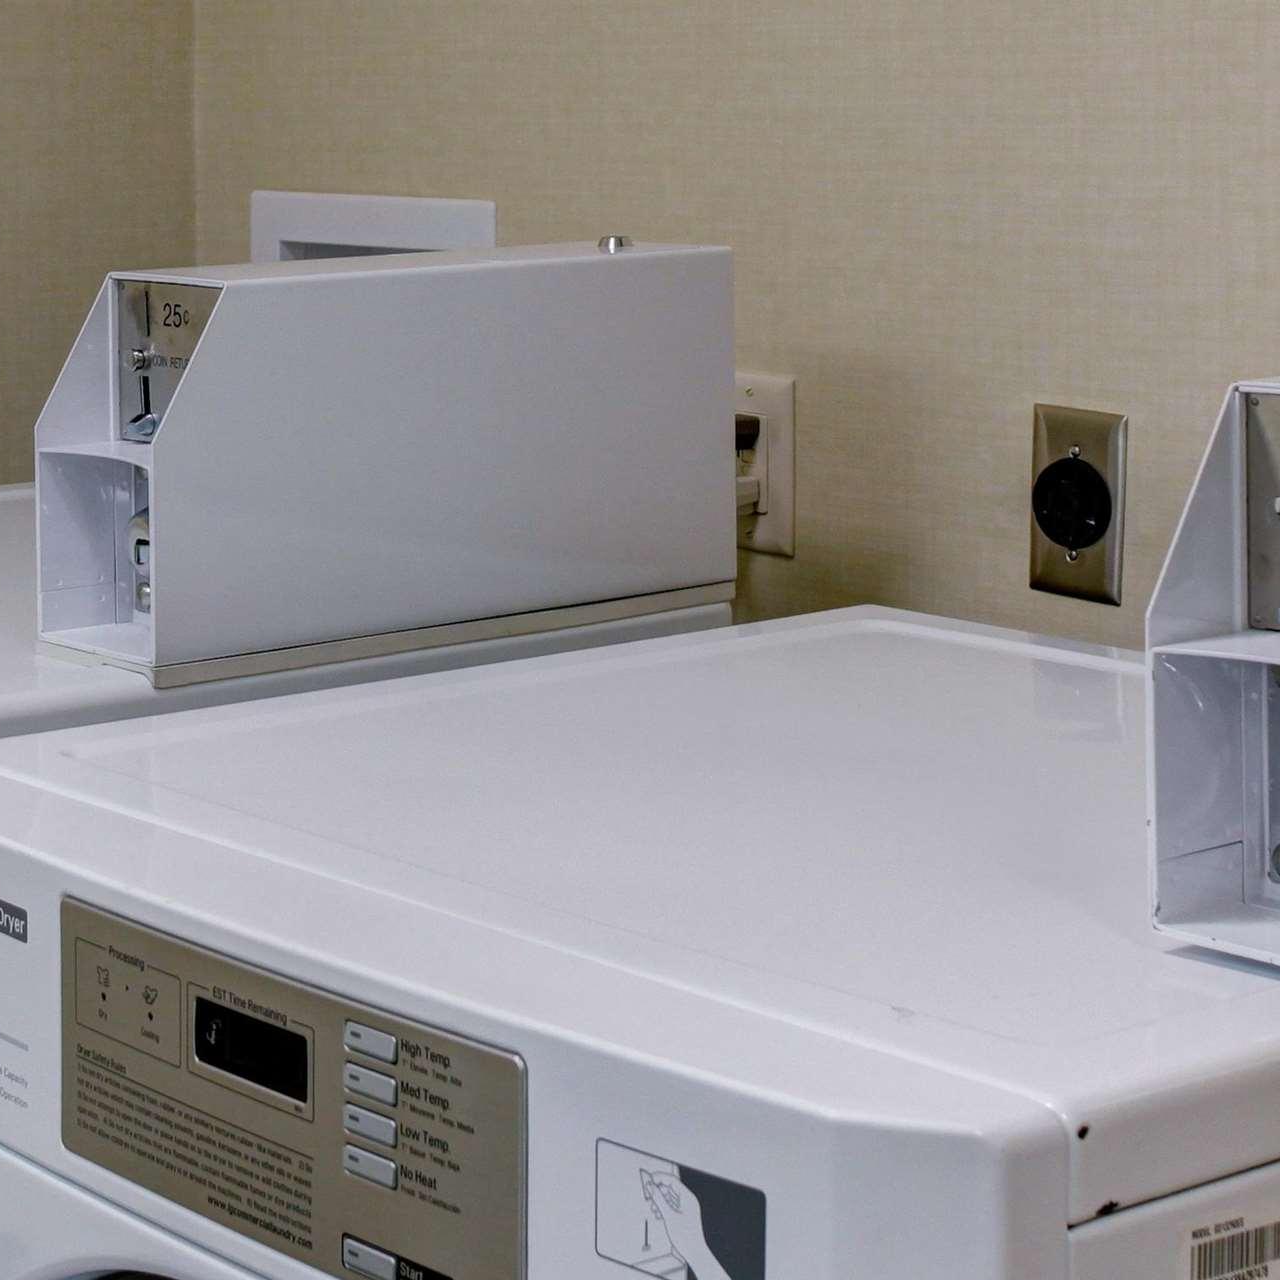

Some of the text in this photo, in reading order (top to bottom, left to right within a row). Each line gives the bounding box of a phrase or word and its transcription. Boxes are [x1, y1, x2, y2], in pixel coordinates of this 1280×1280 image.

[108, 945, 145, 972] Processing
[212, 985, 288, 1027] EST Time Remaining
[400, 1039, 422, 1058] High
[400, 1080, 421, 1099] Med
[400, 1121, 421, 1141] Low
[400, 1164, 438, 1192] No Heat
